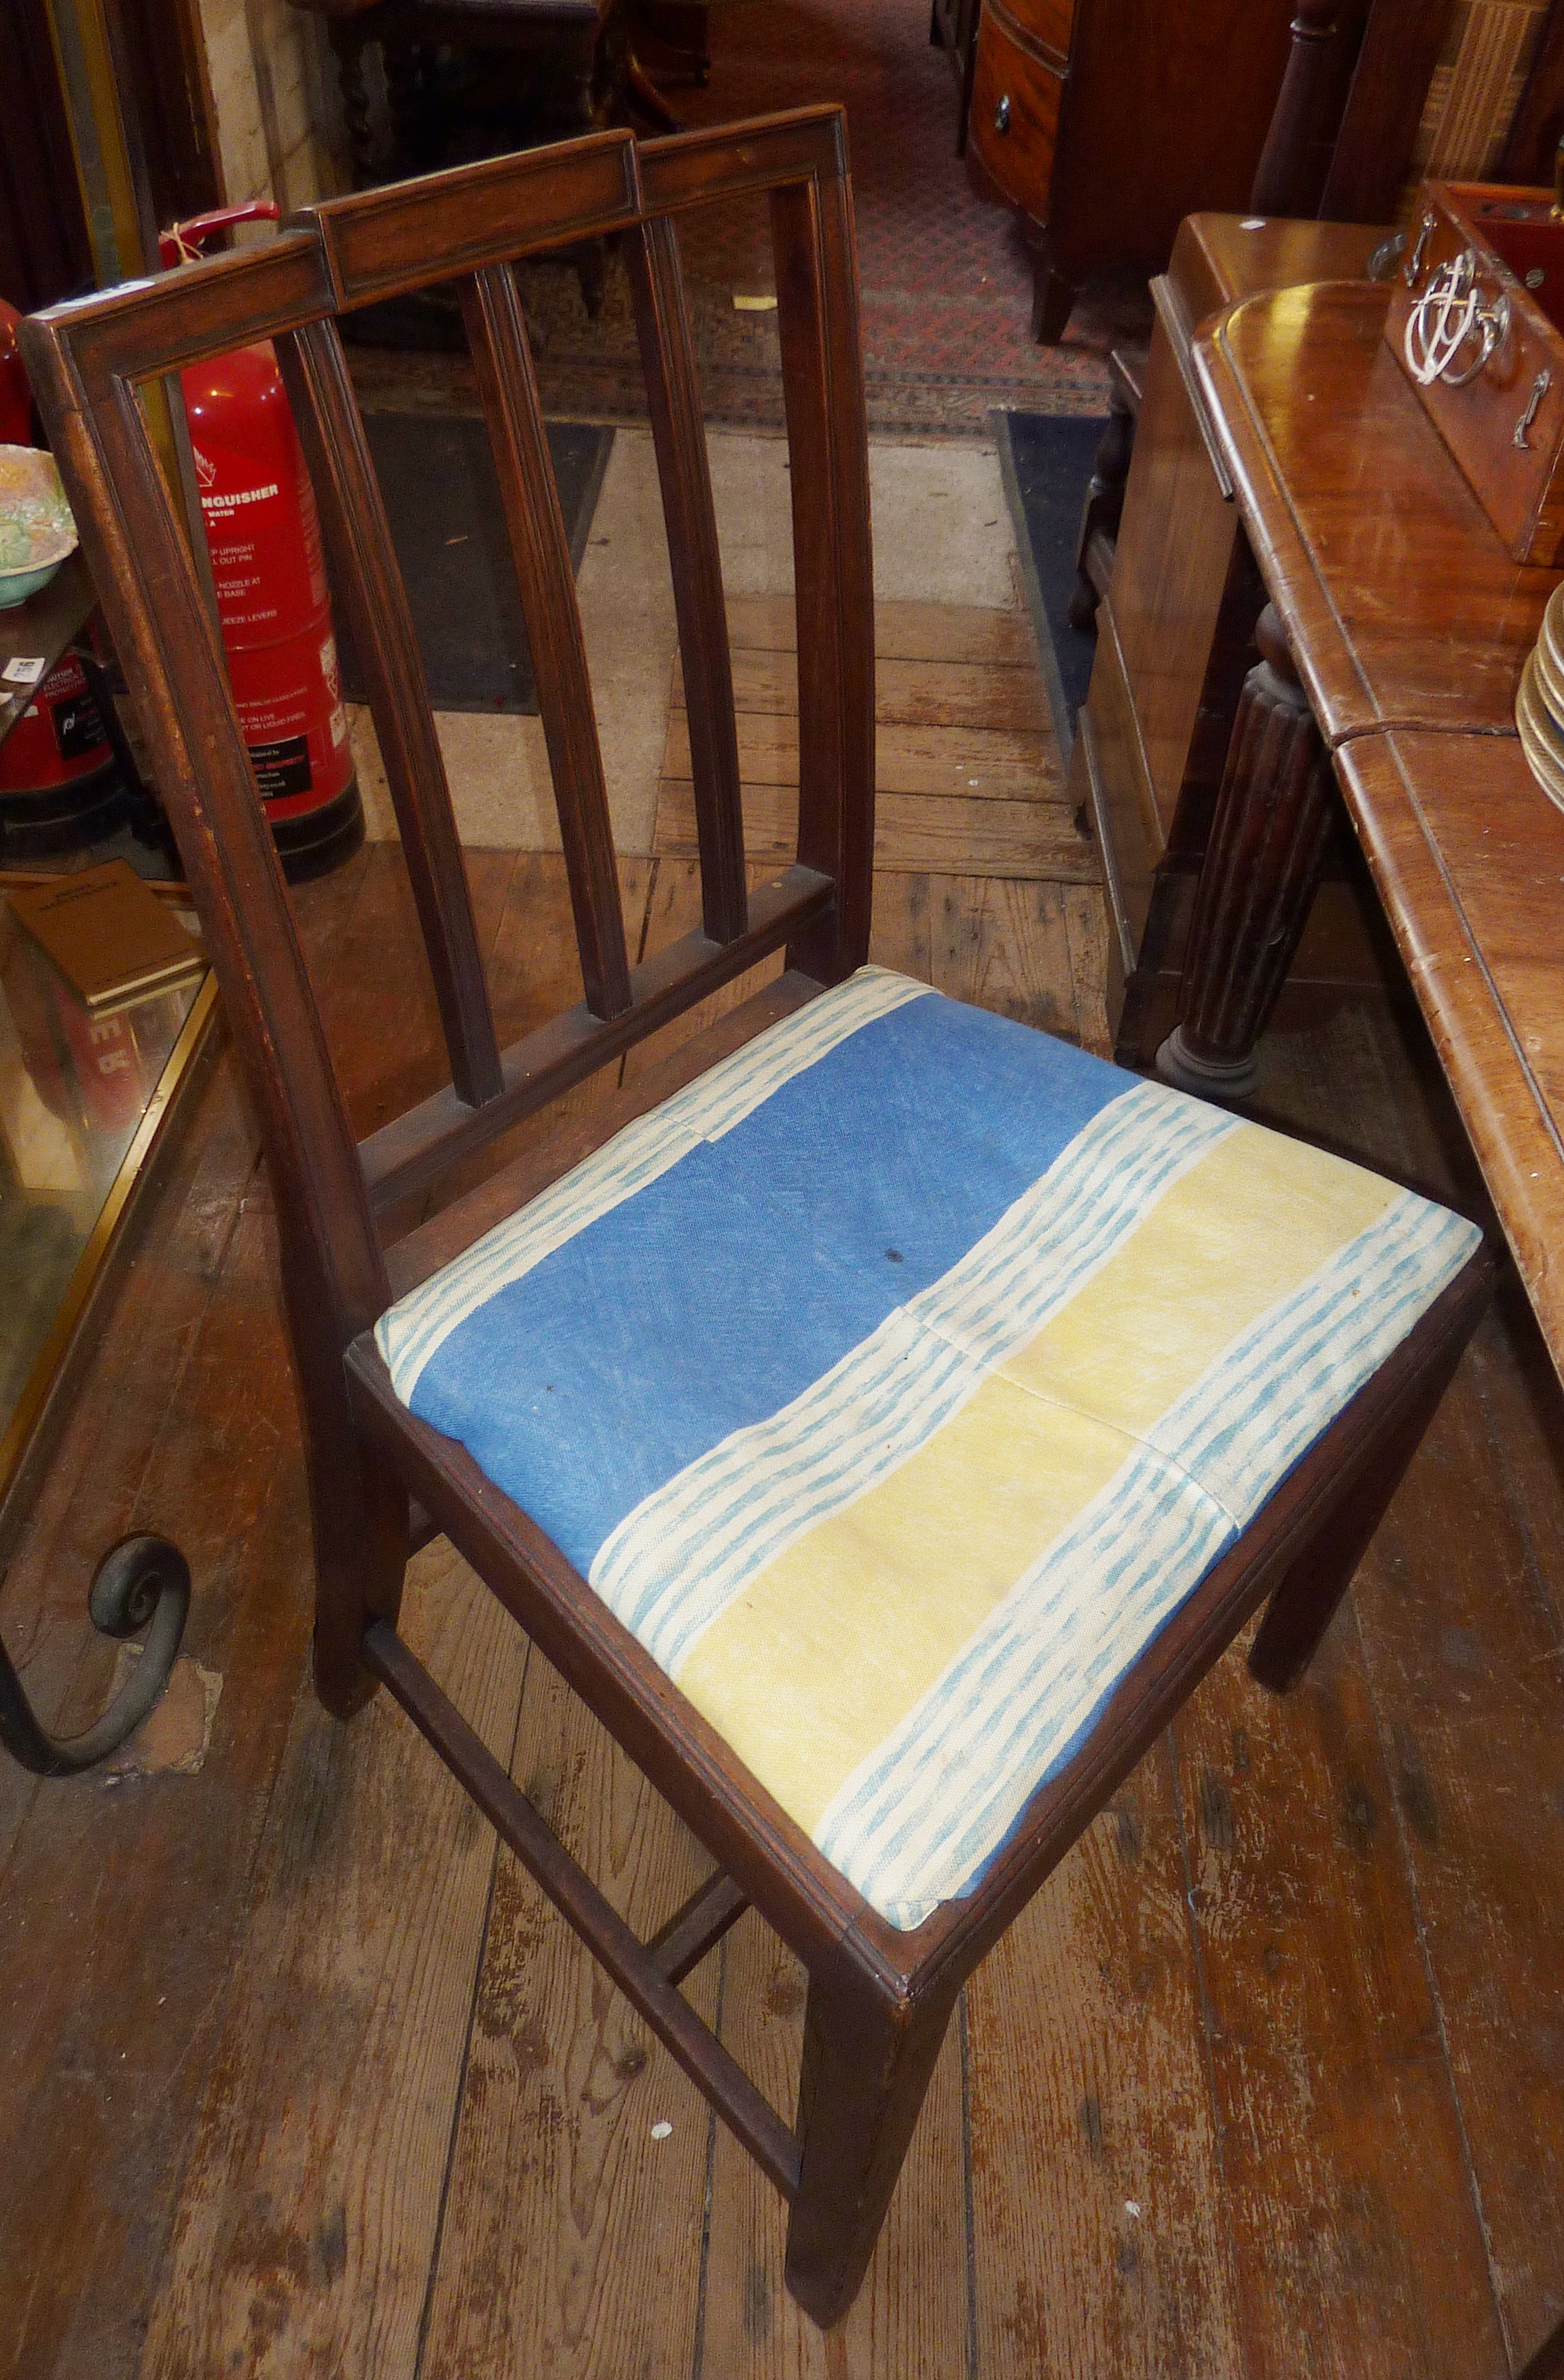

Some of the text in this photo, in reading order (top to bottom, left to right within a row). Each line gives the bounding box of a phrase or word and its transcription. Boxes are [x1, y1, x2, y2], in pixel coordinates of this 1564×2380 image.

[201, 483, 278, 509] NGUISHER
[208, 509, 235, 518] WATER
[219, 544, 255, 555] UPRIGHT
[219, 556, 236, 566] OUT
[238, 553, 253, 562] PIN
[219, 576, 261, 589] NOZZLE AT
[224, 589, 246, 598] BASE
[247, 609, 278, 622] LEVERS
[260, 713, 275, 722] LIVE
[250, 723, 262, 731] OR
[263, 718, 286, 730] LIQUID
